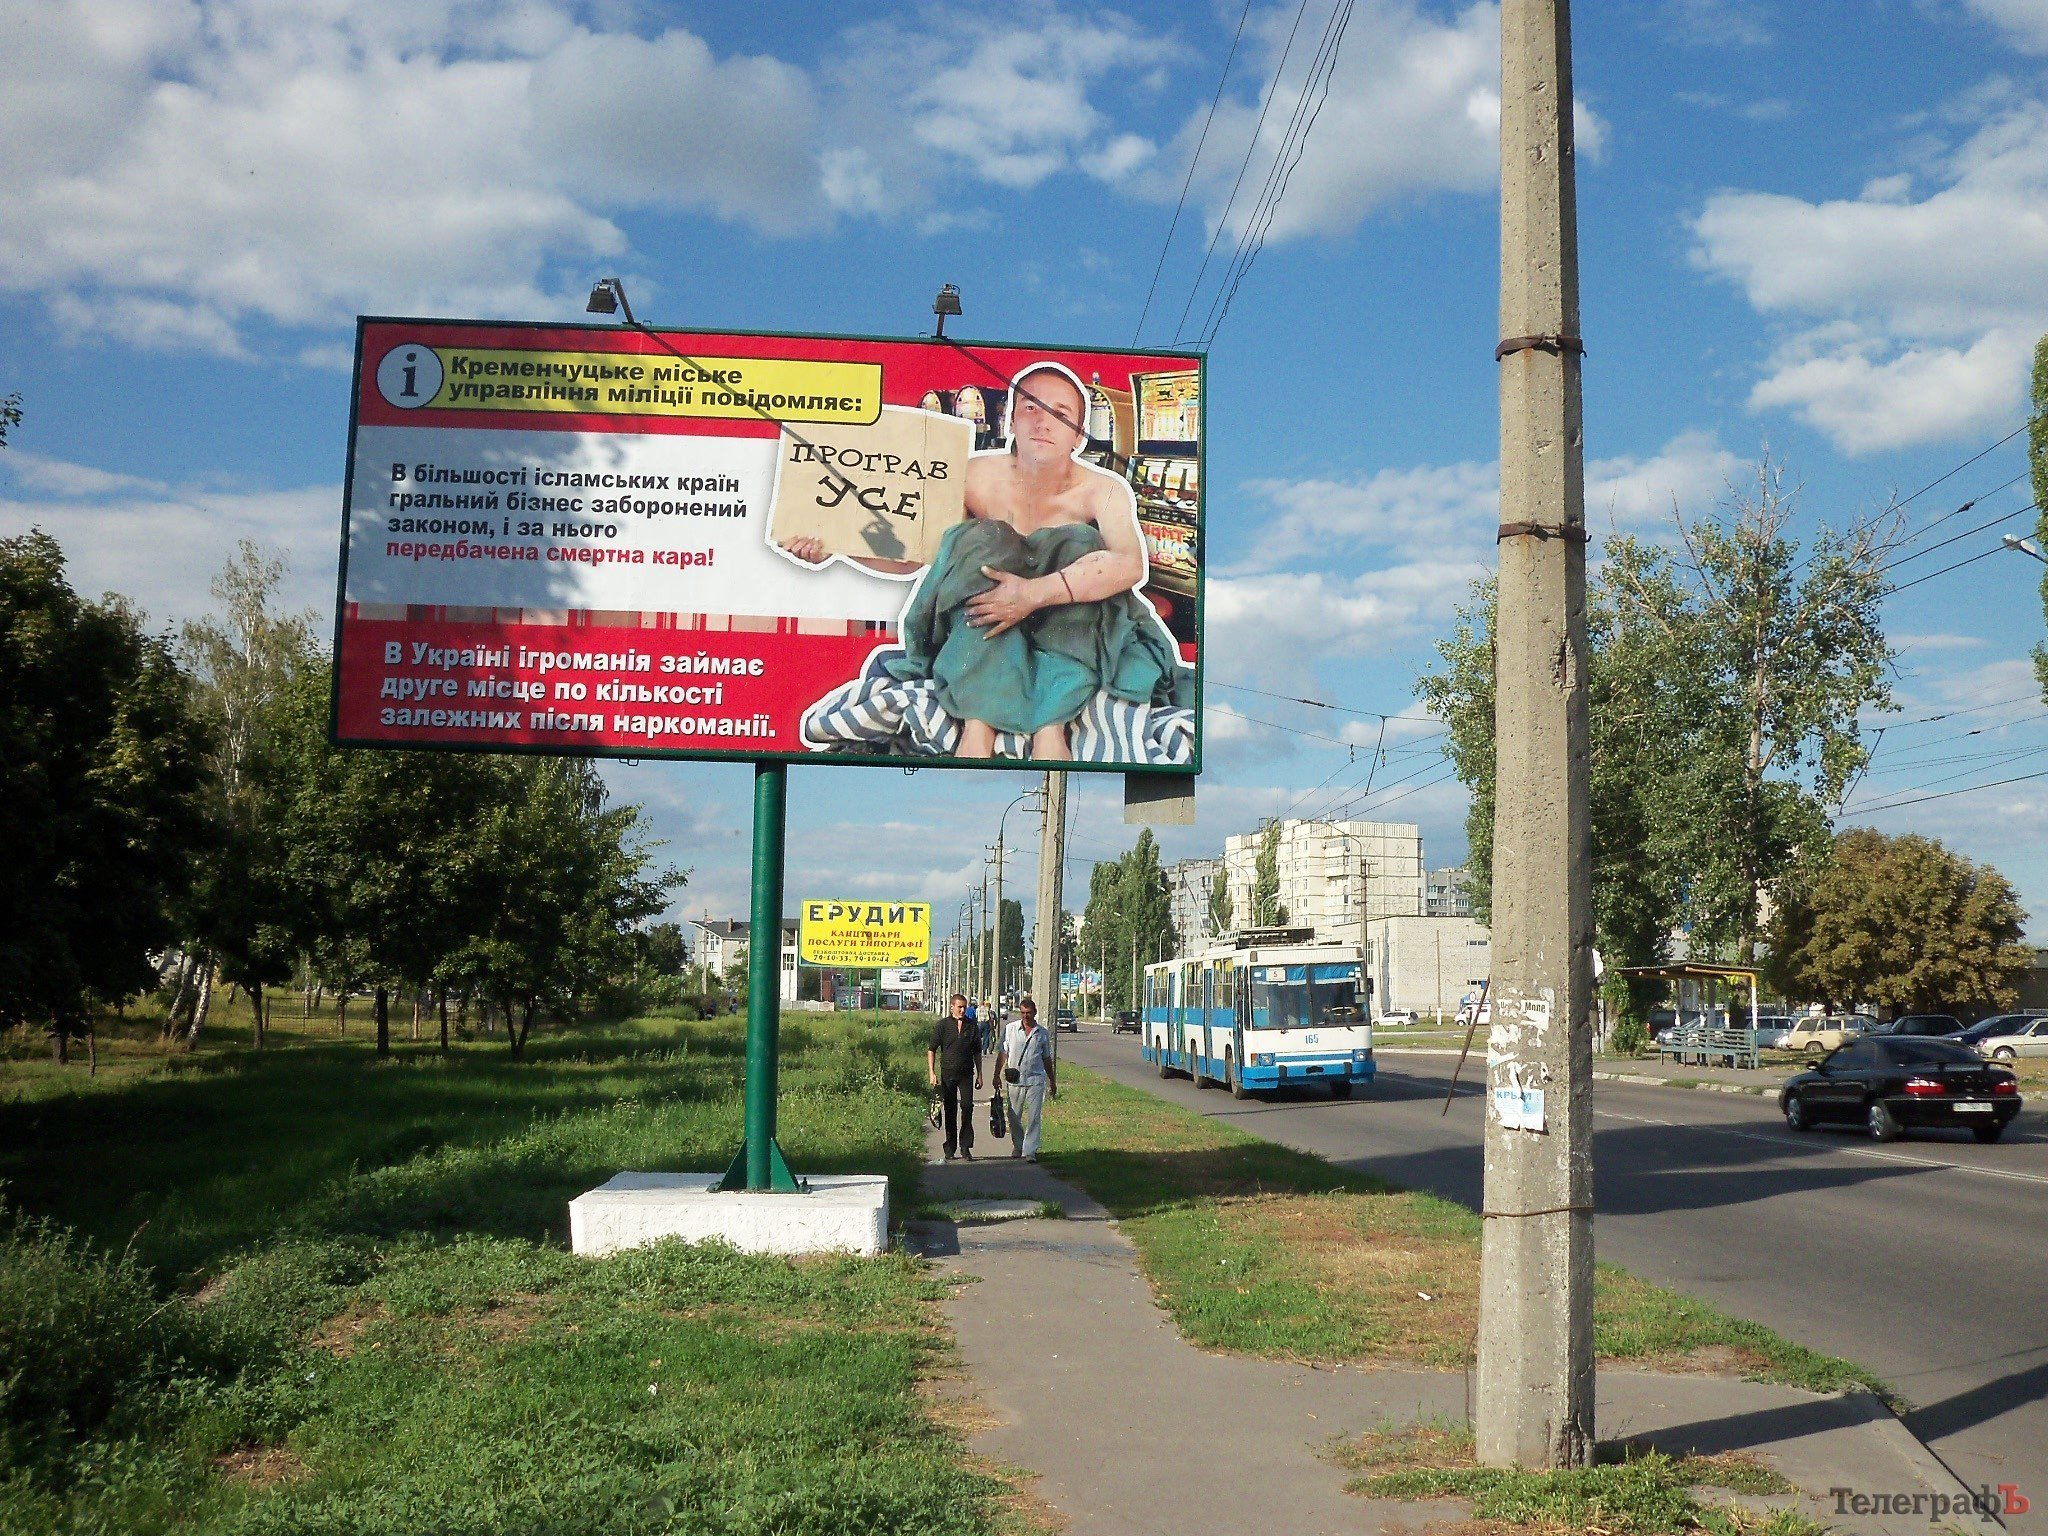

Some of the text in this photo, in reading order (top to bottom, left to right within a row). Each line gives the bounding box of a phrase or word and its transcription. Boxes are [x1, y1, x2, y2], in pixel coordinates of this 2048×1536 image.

[450, 356, 743, 384] Кременчуцьке міське
[449, 382, 862, 412] управління міліції повідомляє:
[789, 443, 949, 481] ПРОГРАВ
[392, 463, 740, 493] В більшості ісламських країн
[389, 490, 748, 519] гральний бізнес заборонений
[815, 475, 921, 520] УСЕ
[388, 516, 618, 539] законом, і за нього
[387, 539, 714, 569] передбачена смертна кара!
[384, 641, 765, 676] В Україні ігроманія займає
[380, 676, 724, 705] друге місце по кількості
[379, 707, 777, 739] залежних після наркоманії.
[810, 904, 924, 926] ЕРУДИТ
[808, 938, 923, 948] ПОСЛУГИ ТИПОГРАФІЇ
[831, 930, 901, 939] КАНЦТОВАРИ
[1305, 1034, 1319, 1044] 165
